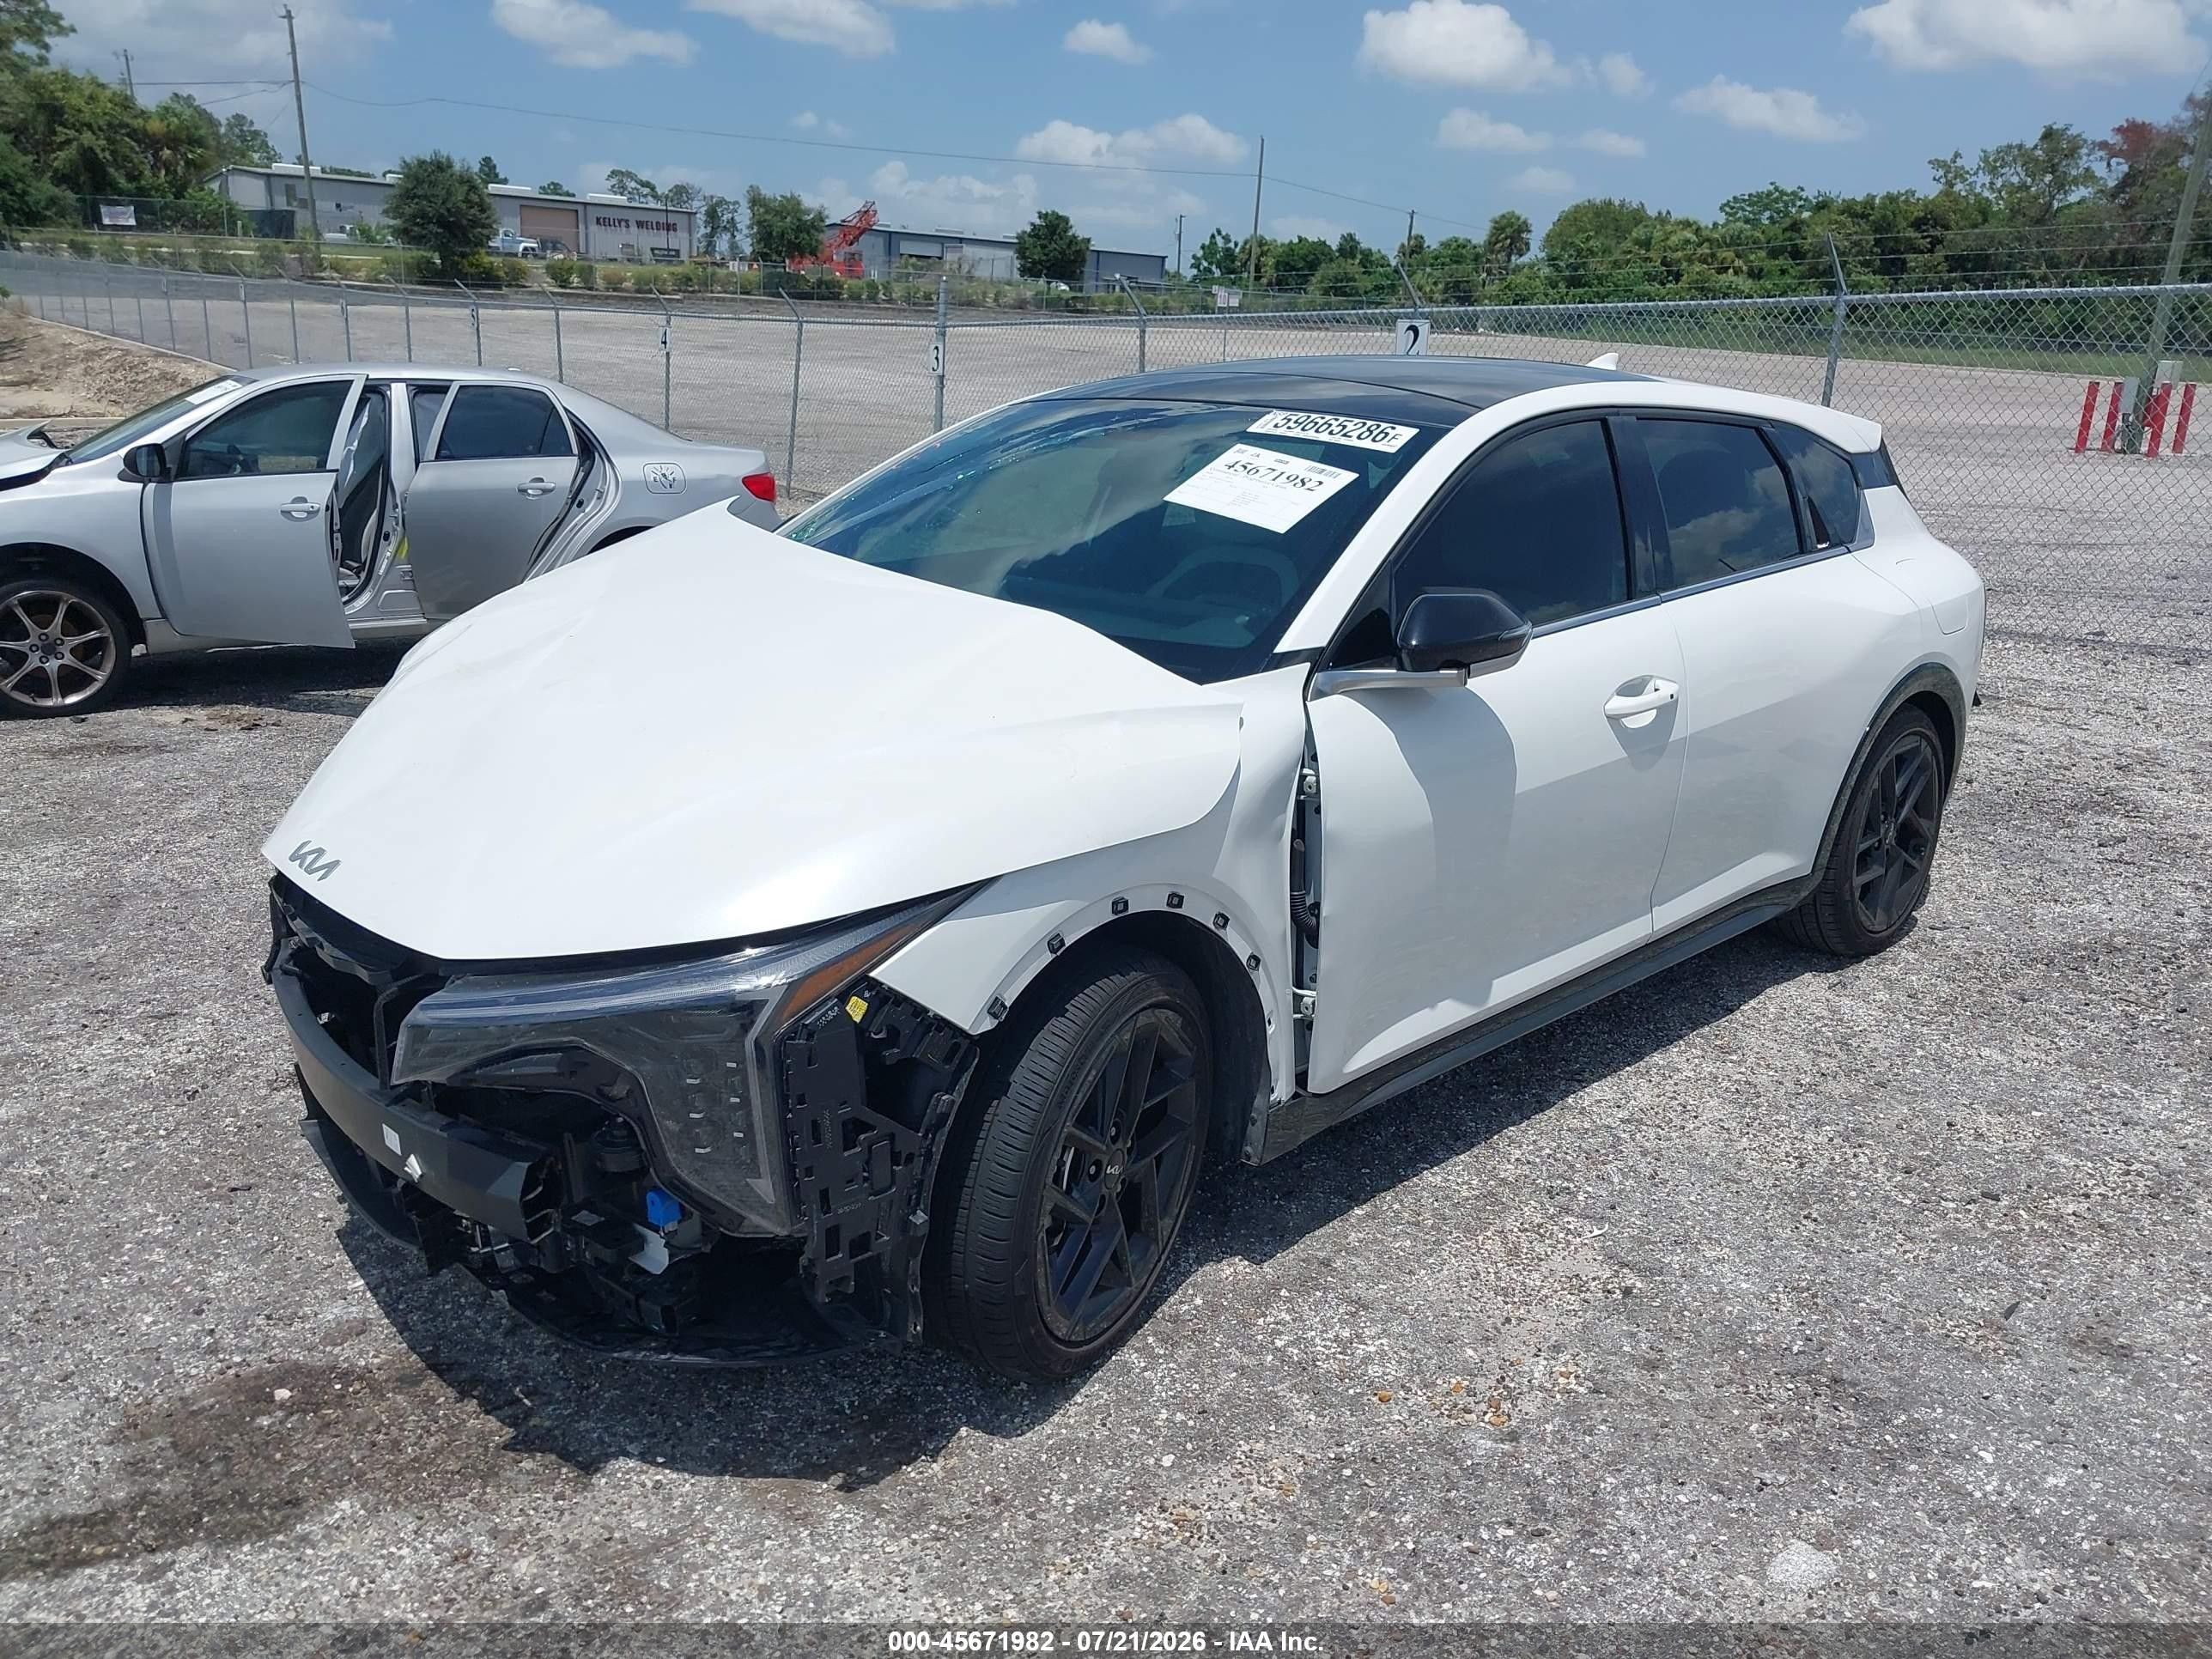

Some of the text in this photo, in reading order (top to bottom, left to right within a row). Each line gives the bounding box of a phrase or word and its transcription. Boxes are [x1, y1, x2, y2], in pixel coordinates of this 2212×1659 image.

[596, 216, 678, 233] KELLY'S WELDING
[660, 328, 667, 349] 4
[1404, 324, 1420, 356] 2
[932, 345, 939, 372] 3
[1273, 413, 1396, 443] 59665286
[1224, 459, 1324, 492] 45671982
